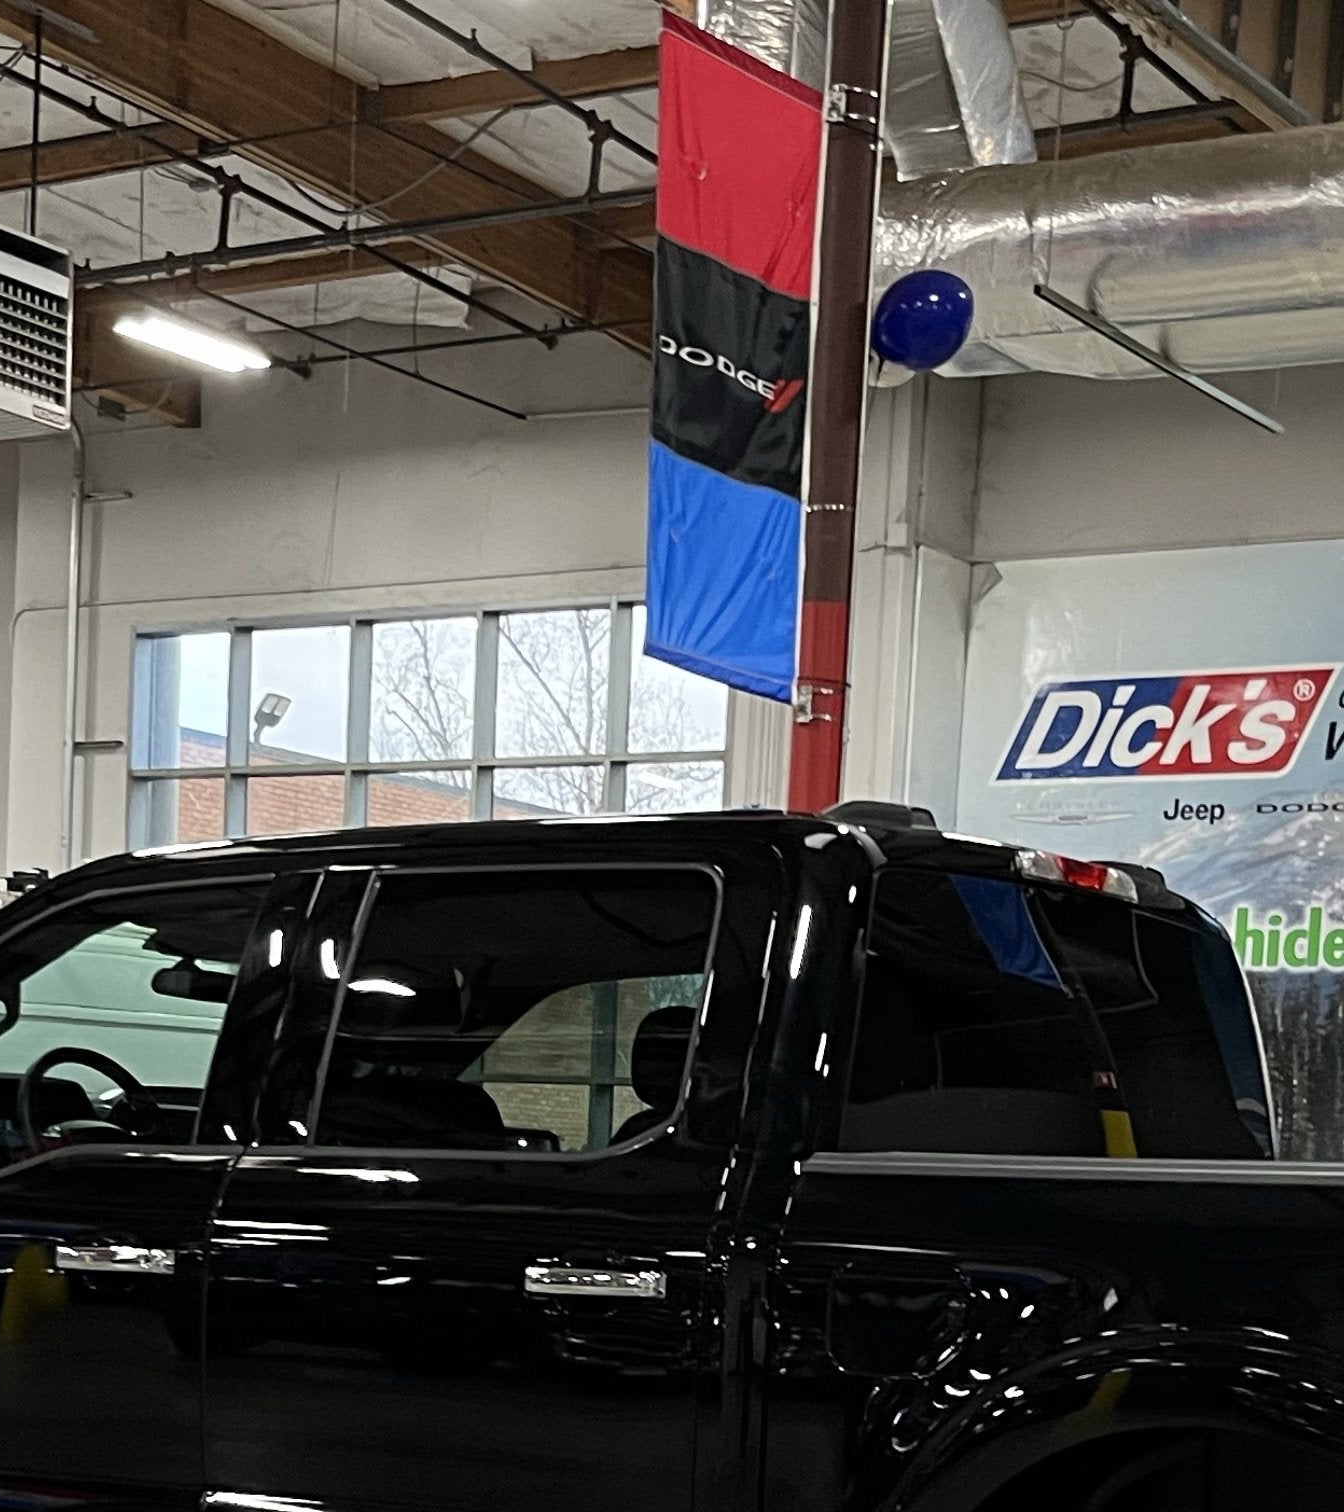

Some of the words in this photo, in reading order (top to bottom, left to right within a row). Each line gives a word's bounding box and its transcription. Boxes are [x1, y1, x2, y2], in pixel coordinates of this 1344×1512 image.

[658, 335, 776, 400] DODGE
[1015, 679, 1297, 770] Dick's
[1163, 798, 1226, 824] Jeep
